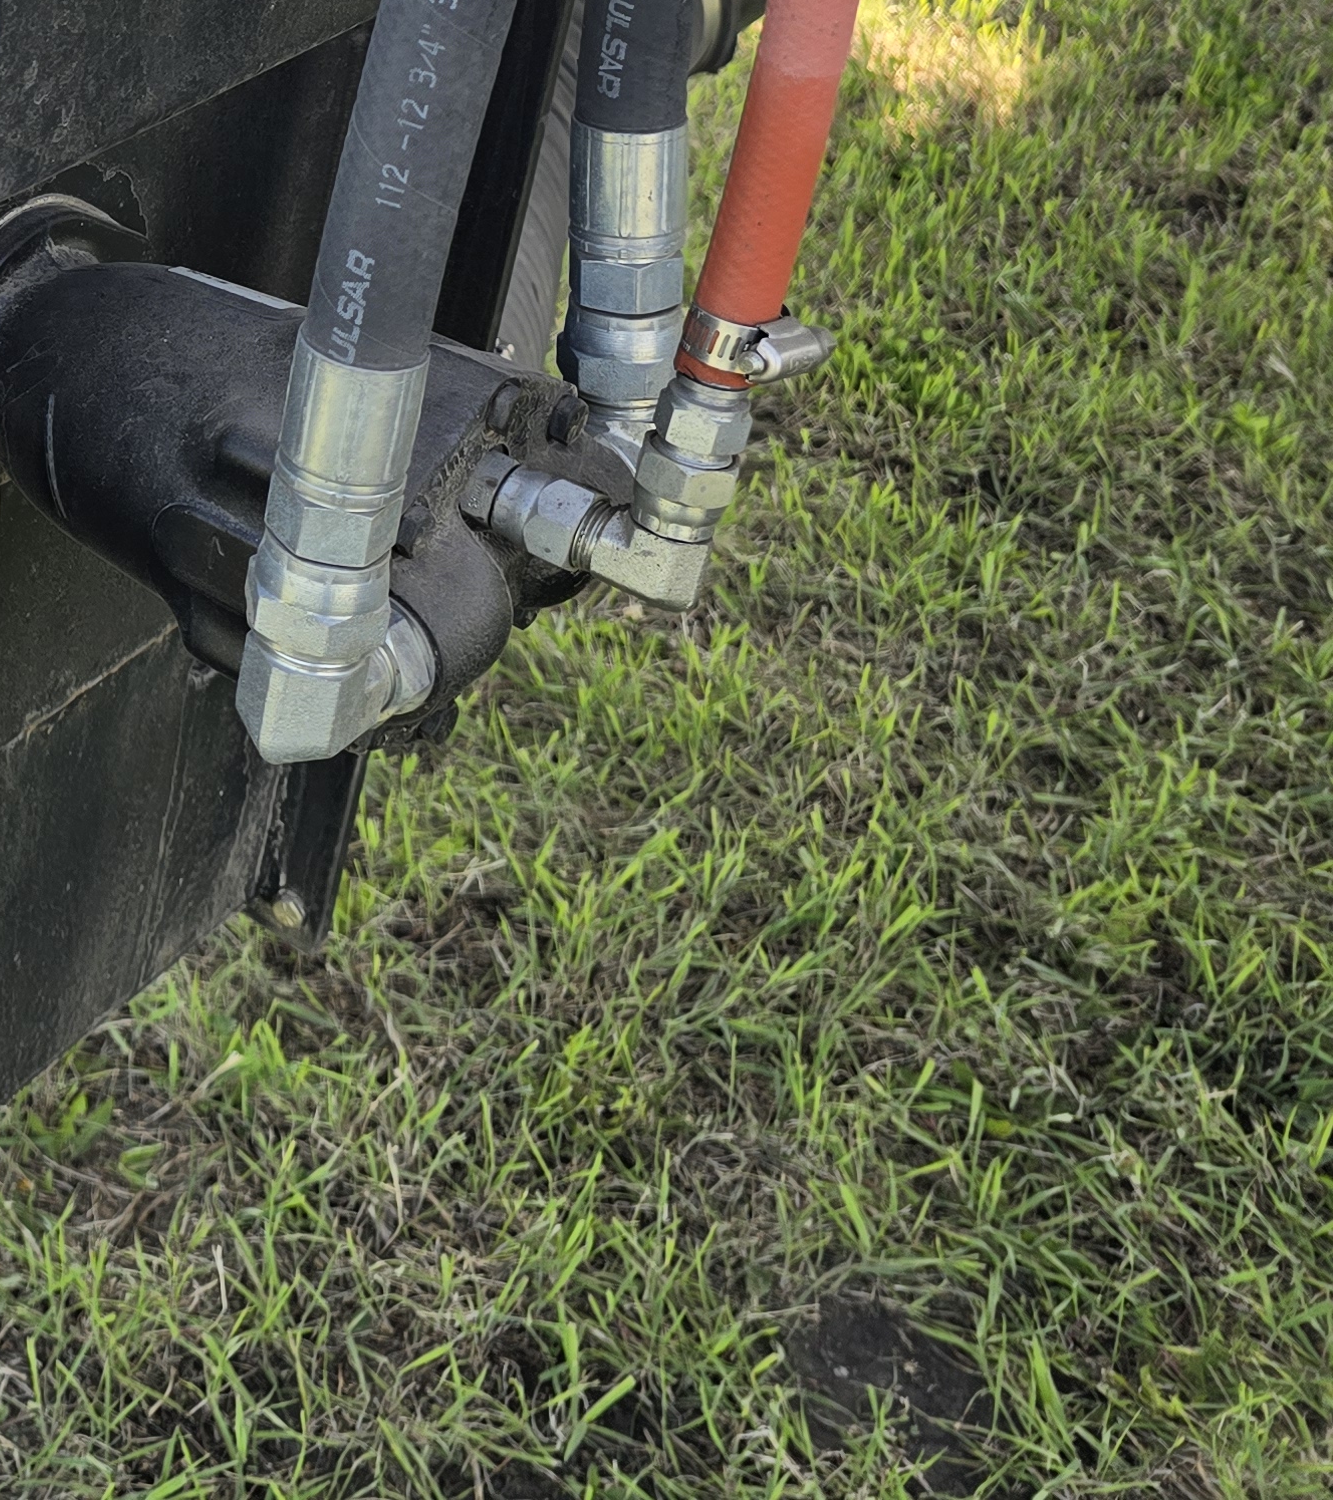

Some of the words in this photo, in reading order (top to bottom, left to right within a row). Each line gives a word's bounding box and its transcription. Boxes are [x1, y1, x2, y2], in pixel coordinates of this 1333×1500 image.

[328, 249, 376, 365] ULSAR
[374, 162, 410, 209] 112
[408, 23, 446, 89] 3/4"
